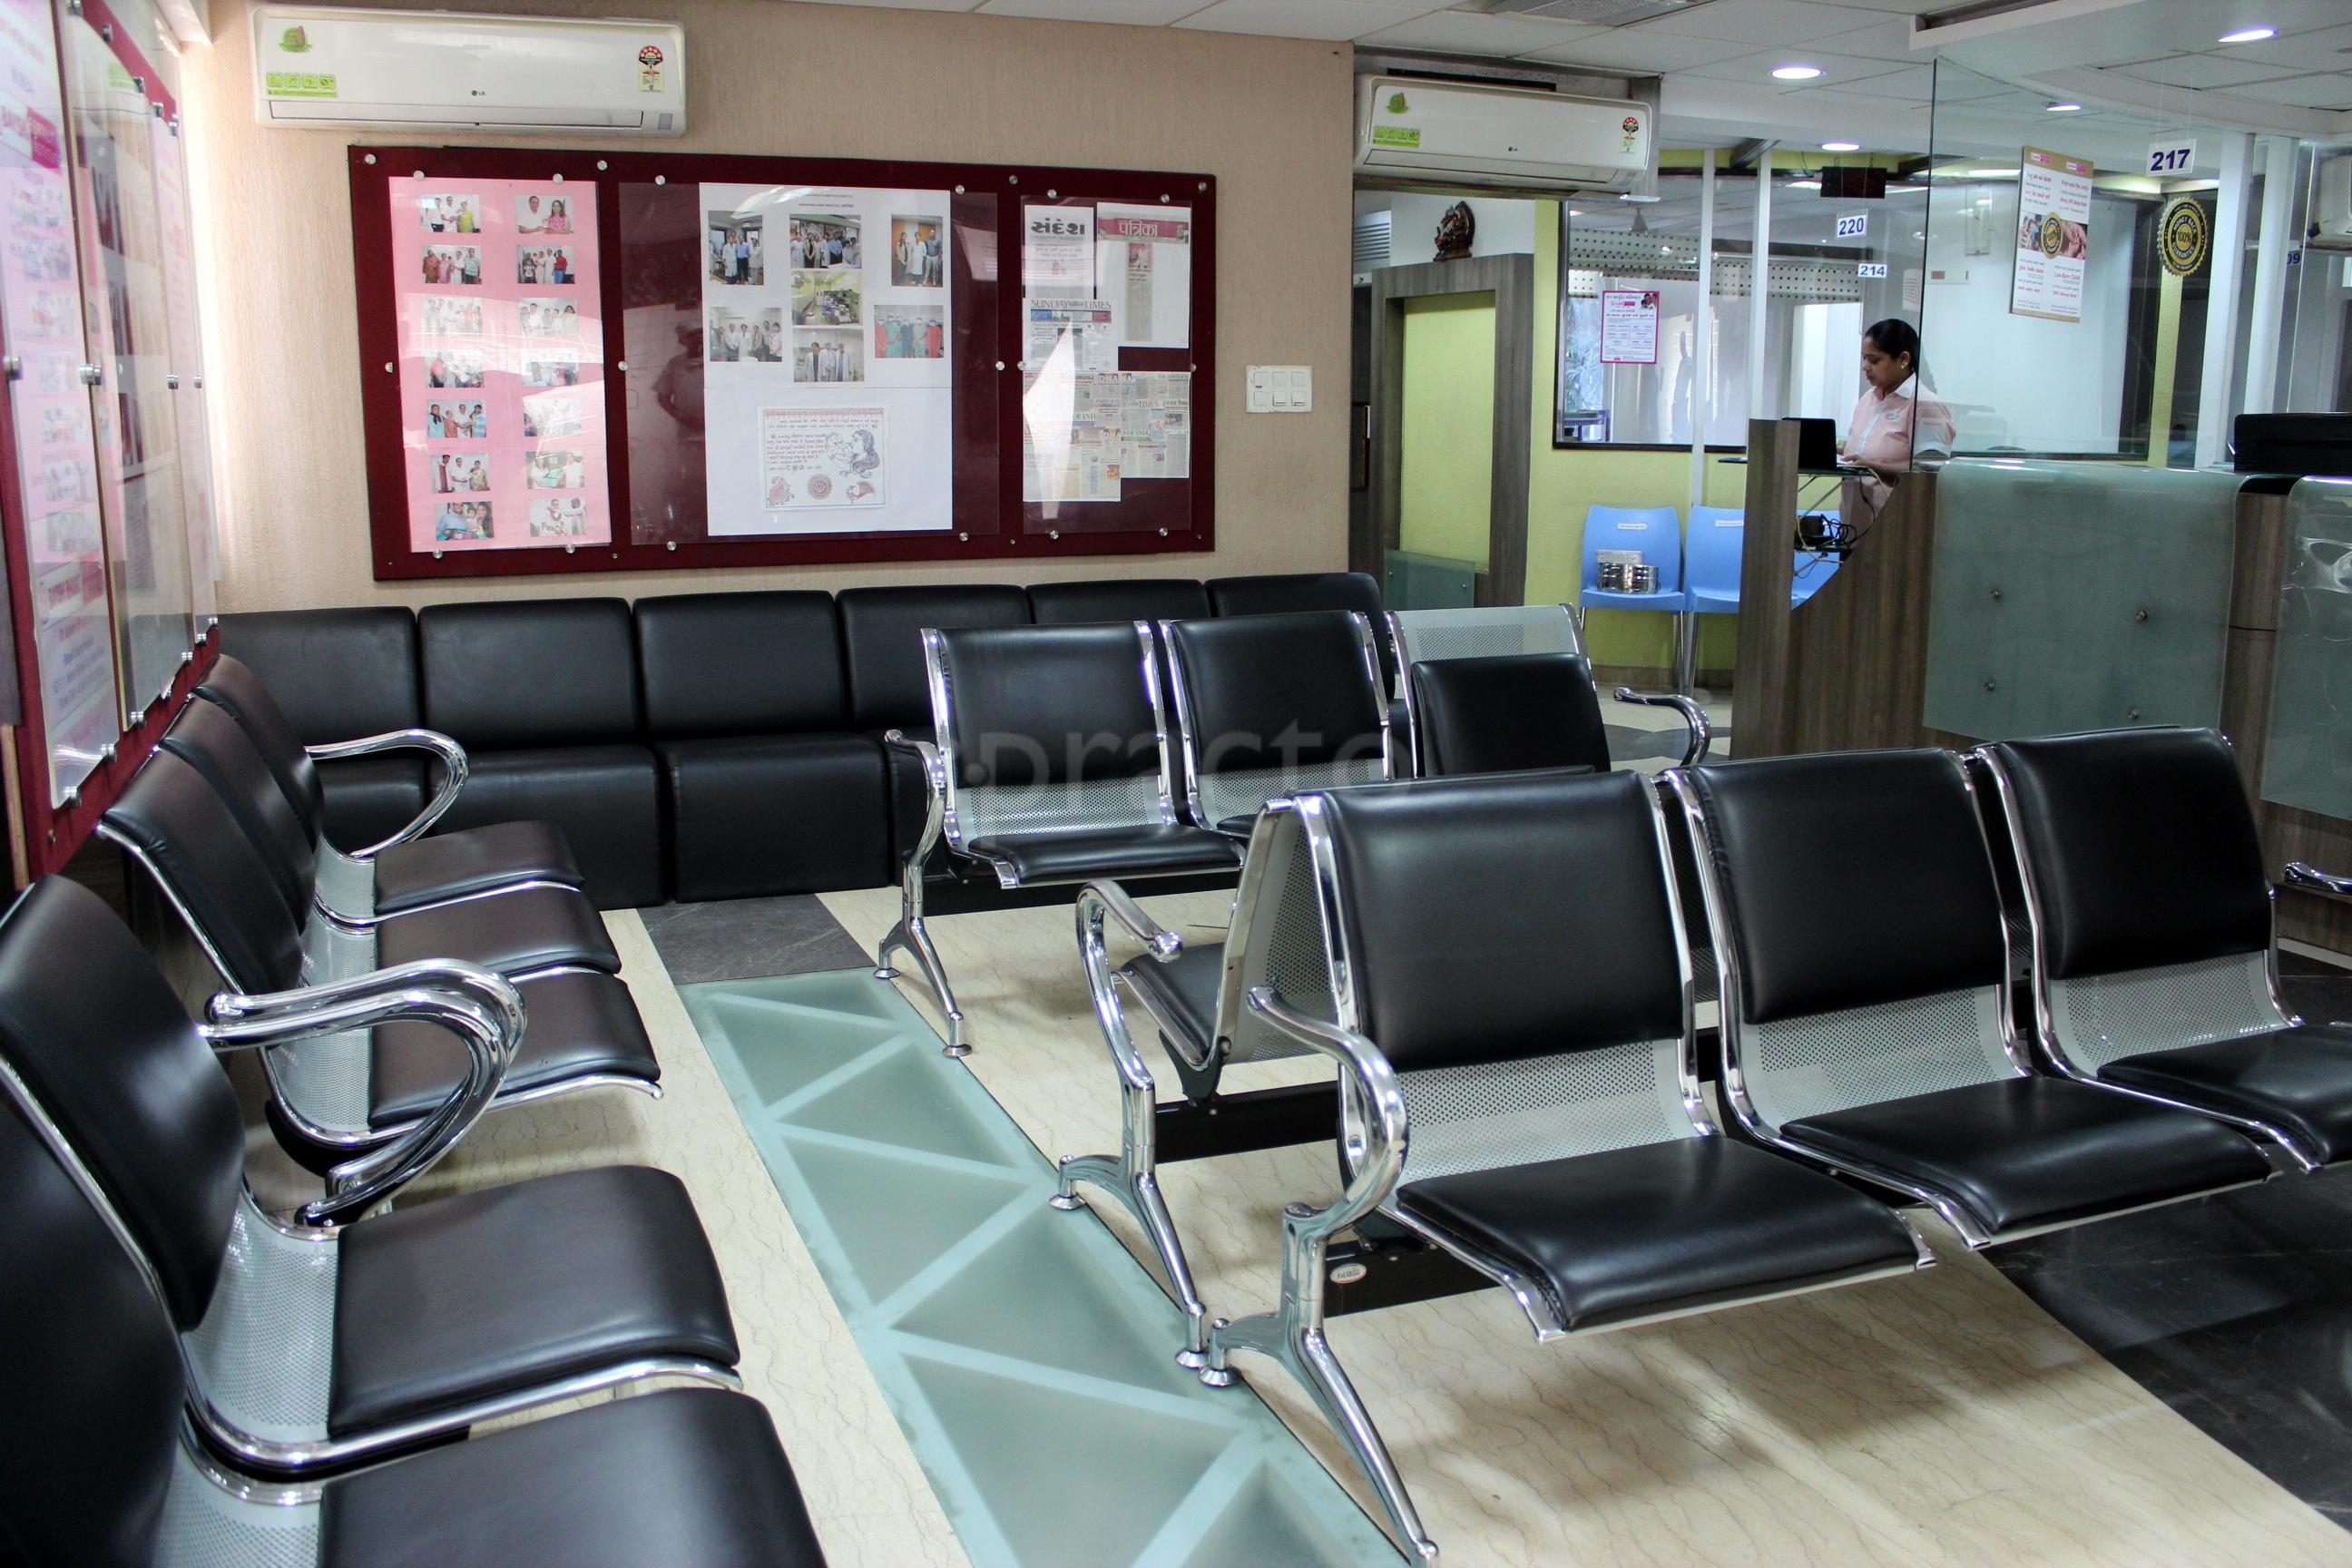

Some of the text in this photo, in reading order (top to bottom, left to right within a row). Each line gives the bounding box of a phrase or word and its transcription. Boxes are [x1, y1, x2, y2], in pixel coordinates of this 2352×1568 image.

[2151, 148, 2190, 171] 217
[1031, 217, 1085, 235] સંદેશ
[1118, 220, 1158, 237] पत्रिका
[1839, 217, 1865, 235] 220
[2173, 216, 2198, 233] MONEY BACK
[2287, 253, 2300, 265] 09
[1859, 265, 1886, 276] 214
[1031, 299, 1112, 309] SUNDAY TIMES
